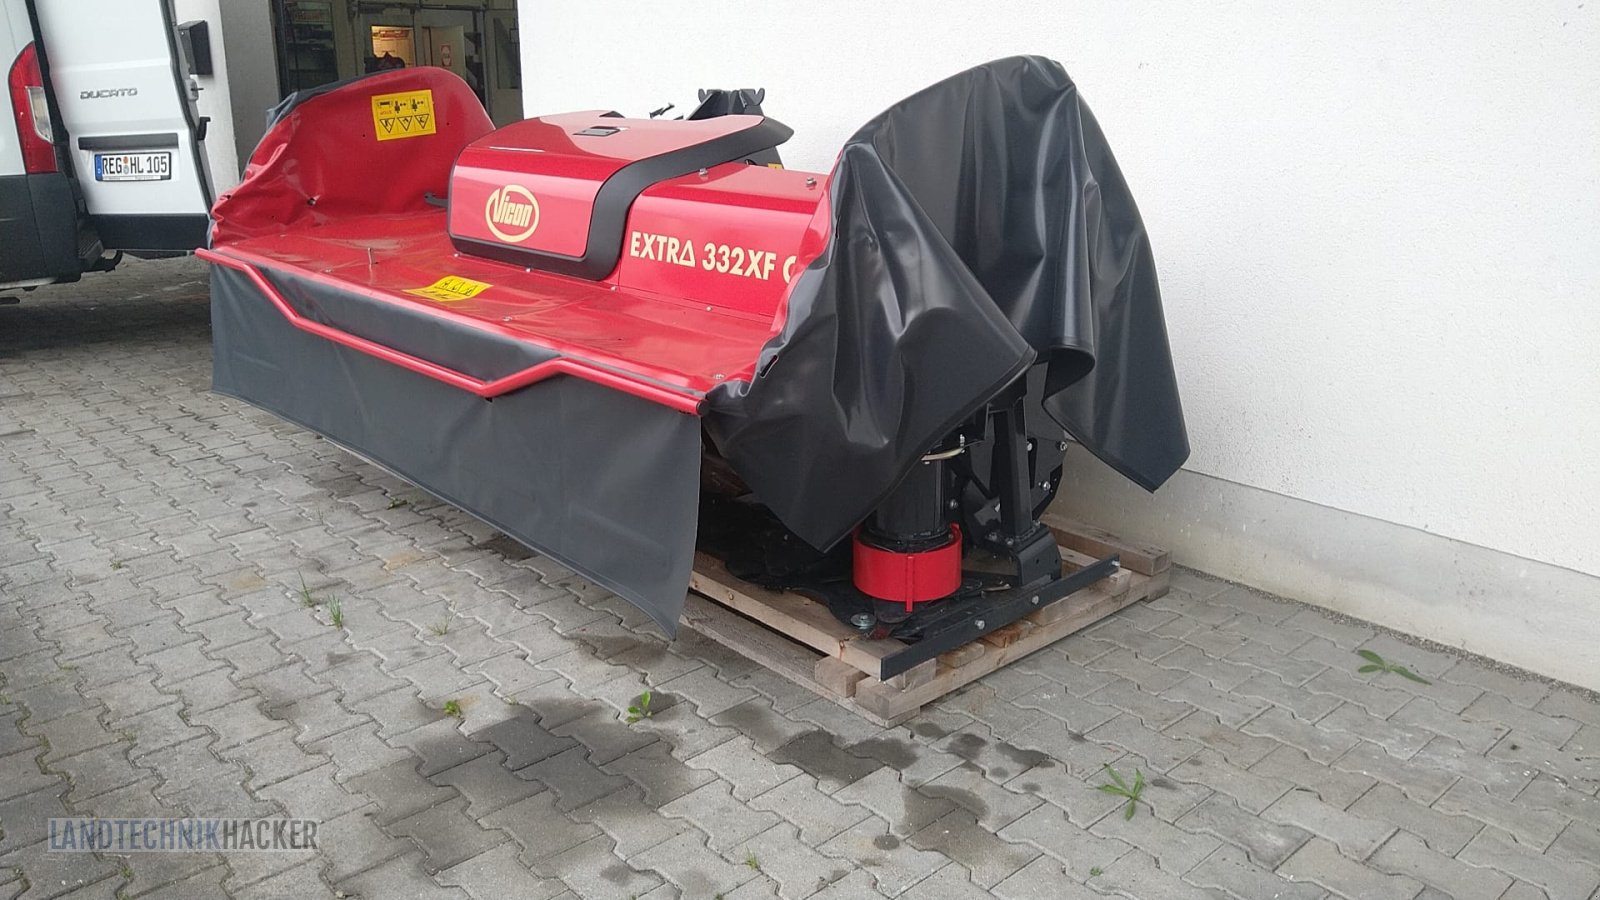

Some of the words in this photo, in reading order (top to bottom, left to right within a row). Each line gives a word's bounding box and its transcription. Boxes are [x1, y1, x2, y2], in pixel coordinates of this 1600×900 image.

[80, 87, 138, 100] DUCATO
[102, 157, 122, 175] REG
[129, 156, 144, 174] HL
[146, 155, 168, 174] 105
[630, 230, 696, 268] EXTRA
[702, 242, 777, 281] 332XF
